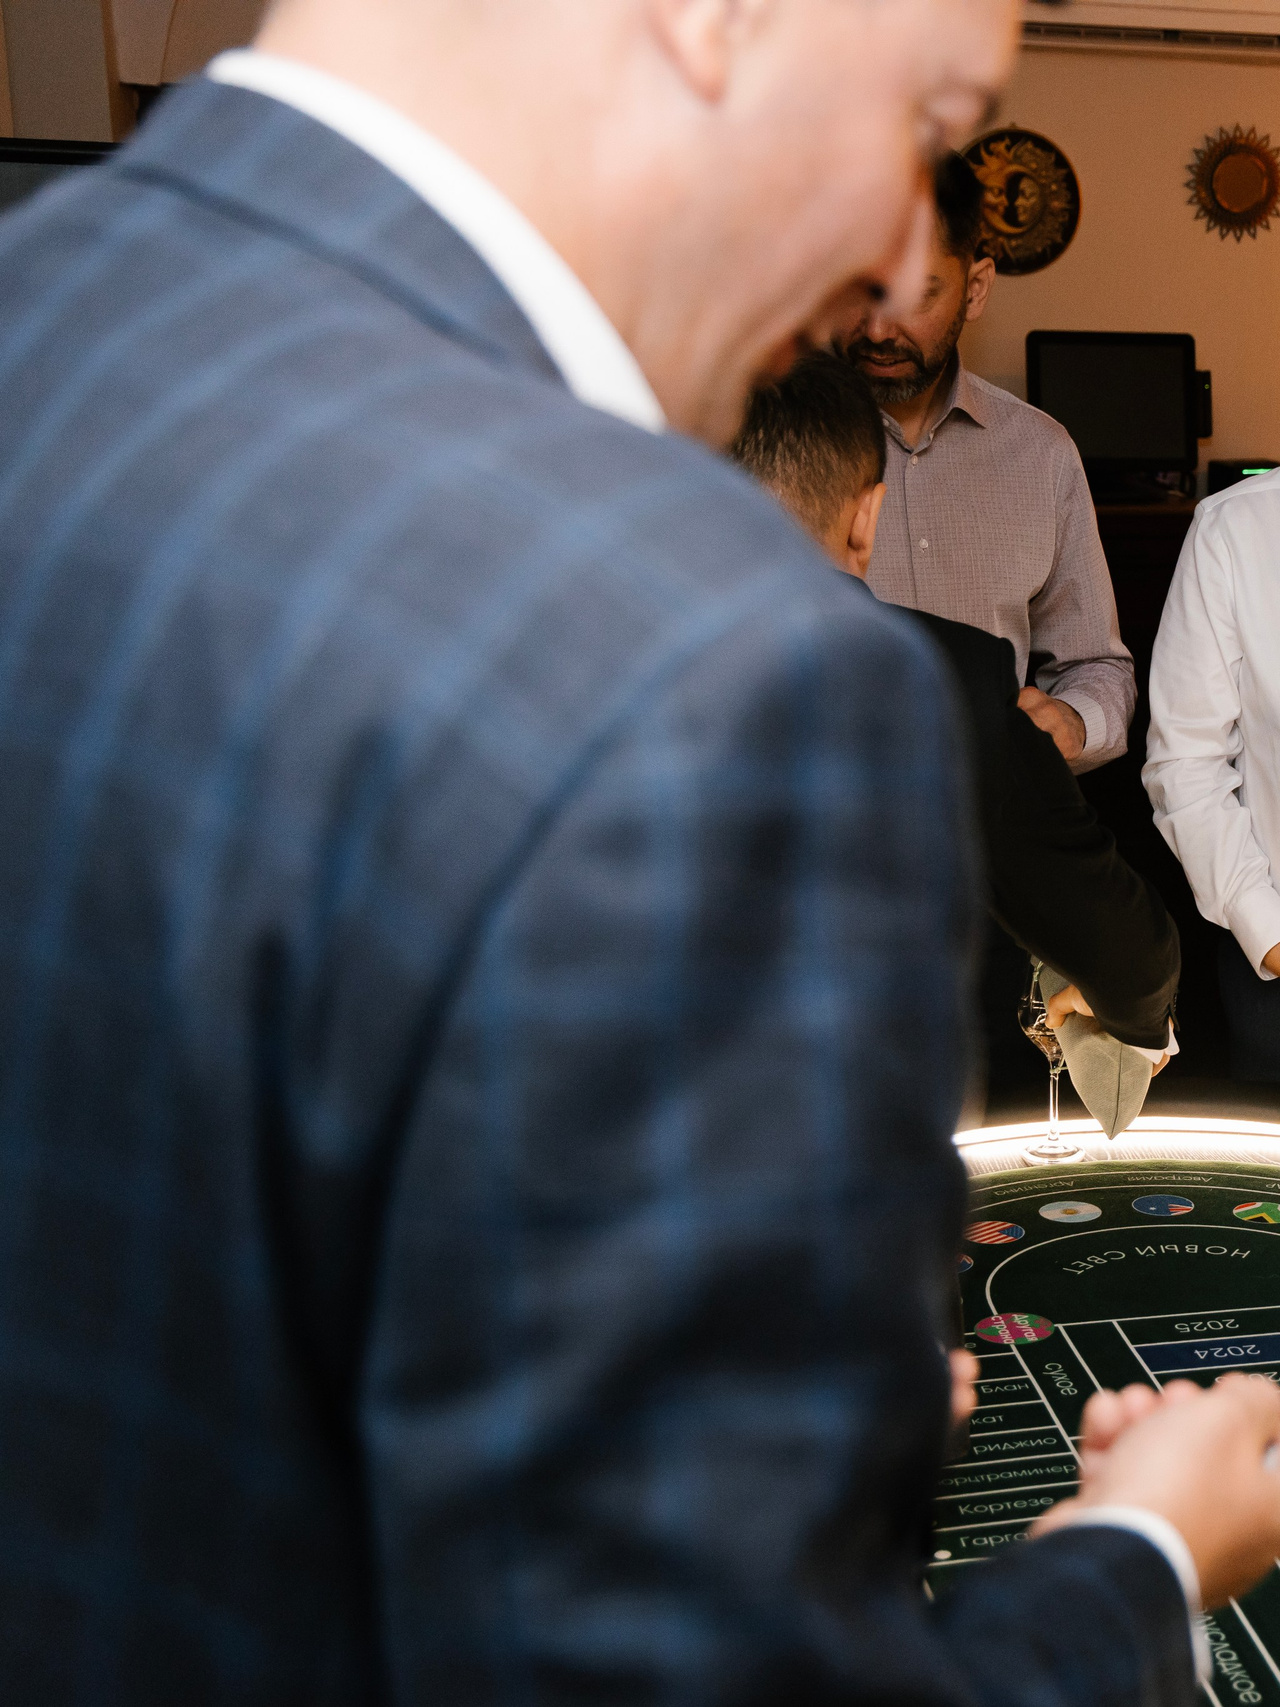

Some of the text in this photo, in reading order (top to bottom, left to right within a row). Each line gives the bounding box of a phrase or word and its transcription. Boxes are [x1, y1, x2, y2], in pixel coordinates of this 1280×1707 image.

[1127, 1174, 1212, 1183] Австралия
[994, 1180, 1074, 1196] Аргентина
[1062, 1244, 1251, 1275] НОВЫЙ СВЕТ
[991, 1315, 1016, 1344] страна
[1012, 1313, 1039, 1342] Другая
[1174, 1318, 1240, 1334] 2025
[1194, 1344, 1261, 1360] 2024
[1043, 1362, 1078, 1396] сухое
[980, 1382, 1030, 1394] Блан
[970, 1415, 1005, 1425] кат
[973, 1437, 1057, 1455] риджио
[958, 1496, 1054, 1515] Кортезе
[960, 1532, 1028, 1548] Гарга
